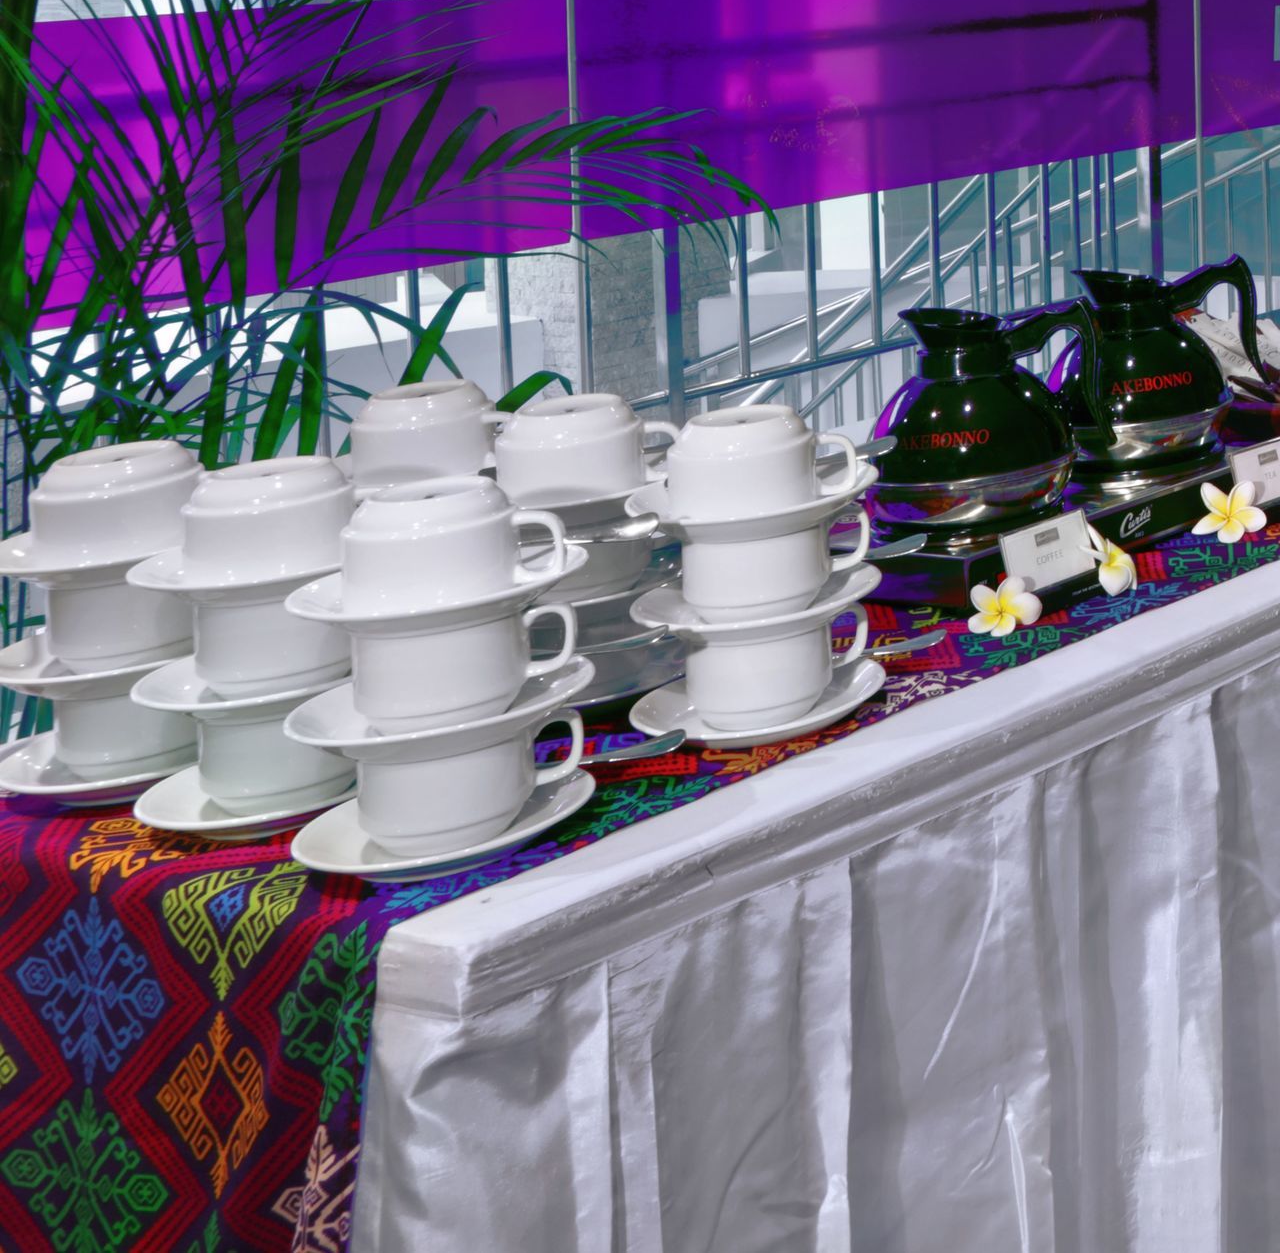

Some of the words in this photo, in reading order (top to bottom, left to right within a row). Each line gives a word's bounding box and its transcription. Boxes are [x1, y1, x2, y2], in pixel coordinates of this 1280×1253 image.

[1111, 371, 1193, 395] AKEBONNO
[1119, 505, 1152, 538] Curtis
[1036, 548, 1064, 566] COFFEE
